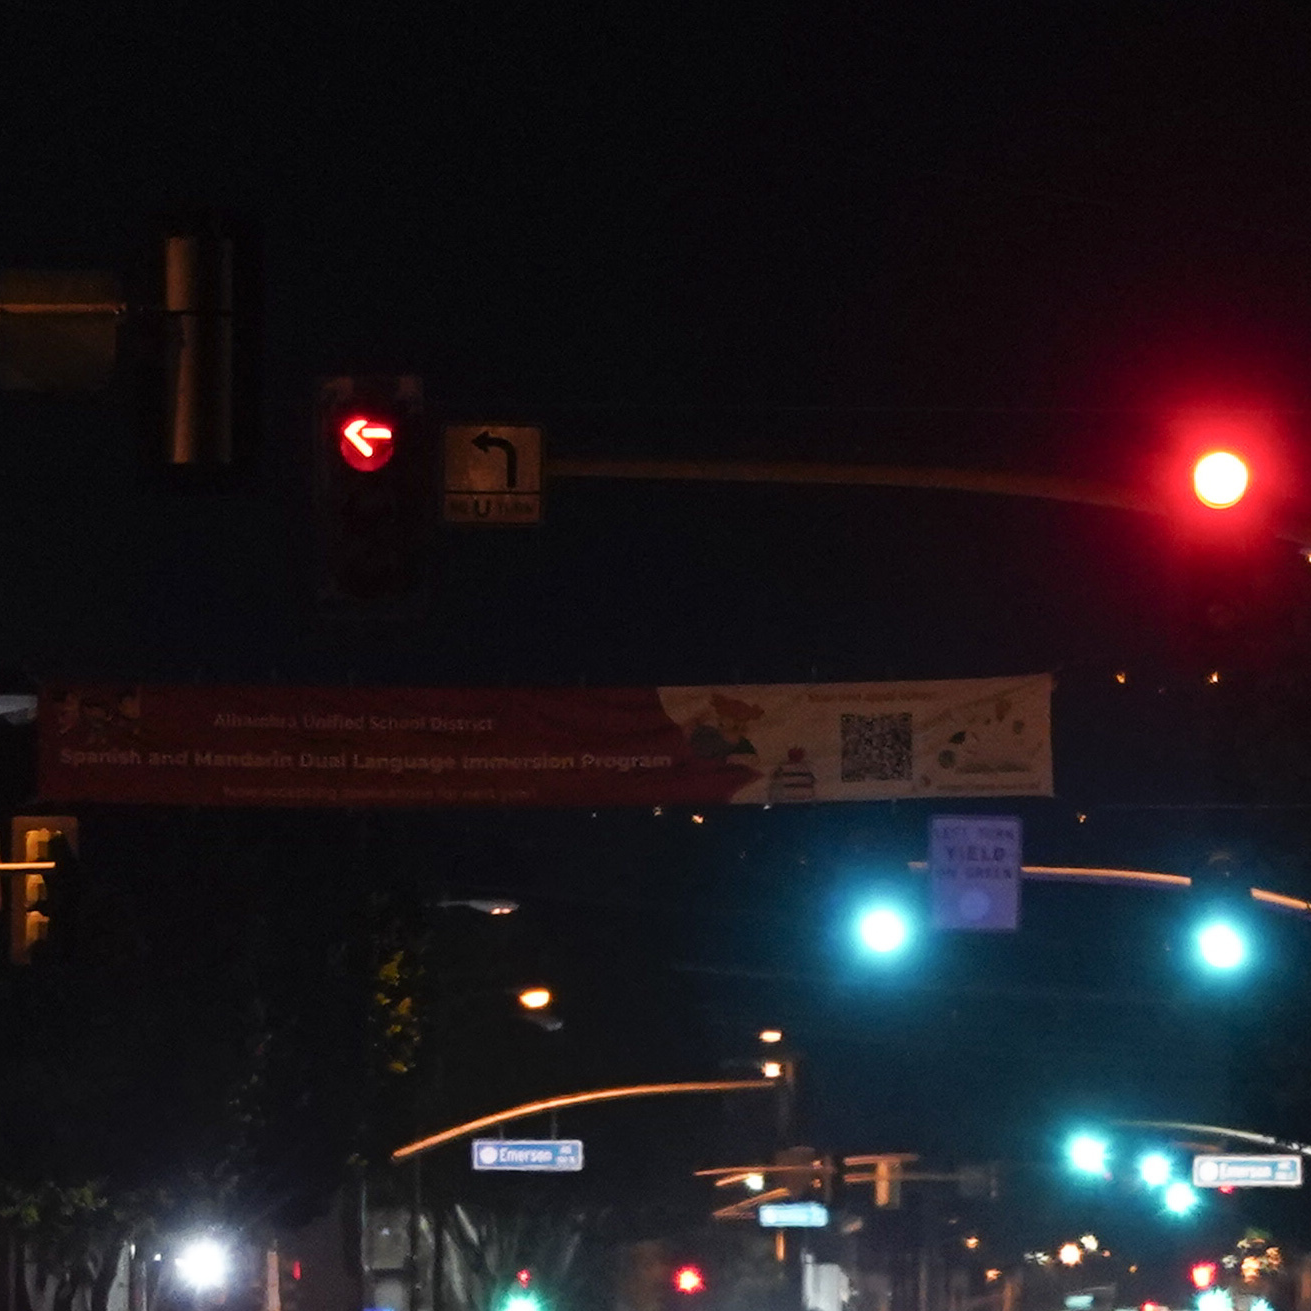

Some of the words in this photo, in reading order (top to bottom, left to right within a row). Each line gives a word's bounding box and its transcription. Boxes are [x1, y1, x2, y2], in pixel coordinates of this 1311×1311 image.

[474, 499, 491, 517] U
[302, 713, 364, 731] Unified
[369, 714, 425, 731] School
[430, 715, 493, 733] District
[60, 746, 142, 768] Spanish
[148, 749, 189, 767] and
[194, 748, 293, 769] Mandarin
[299, 751, 346, 769] Dual
[352, 752, 457, 774] Language
[462, 752, 575, 770] Immersion
[581, 752, 673, 773] Program
[946, 845, 1005, 861] YIELD
[499, 1147, 553, 1163] Emerson
